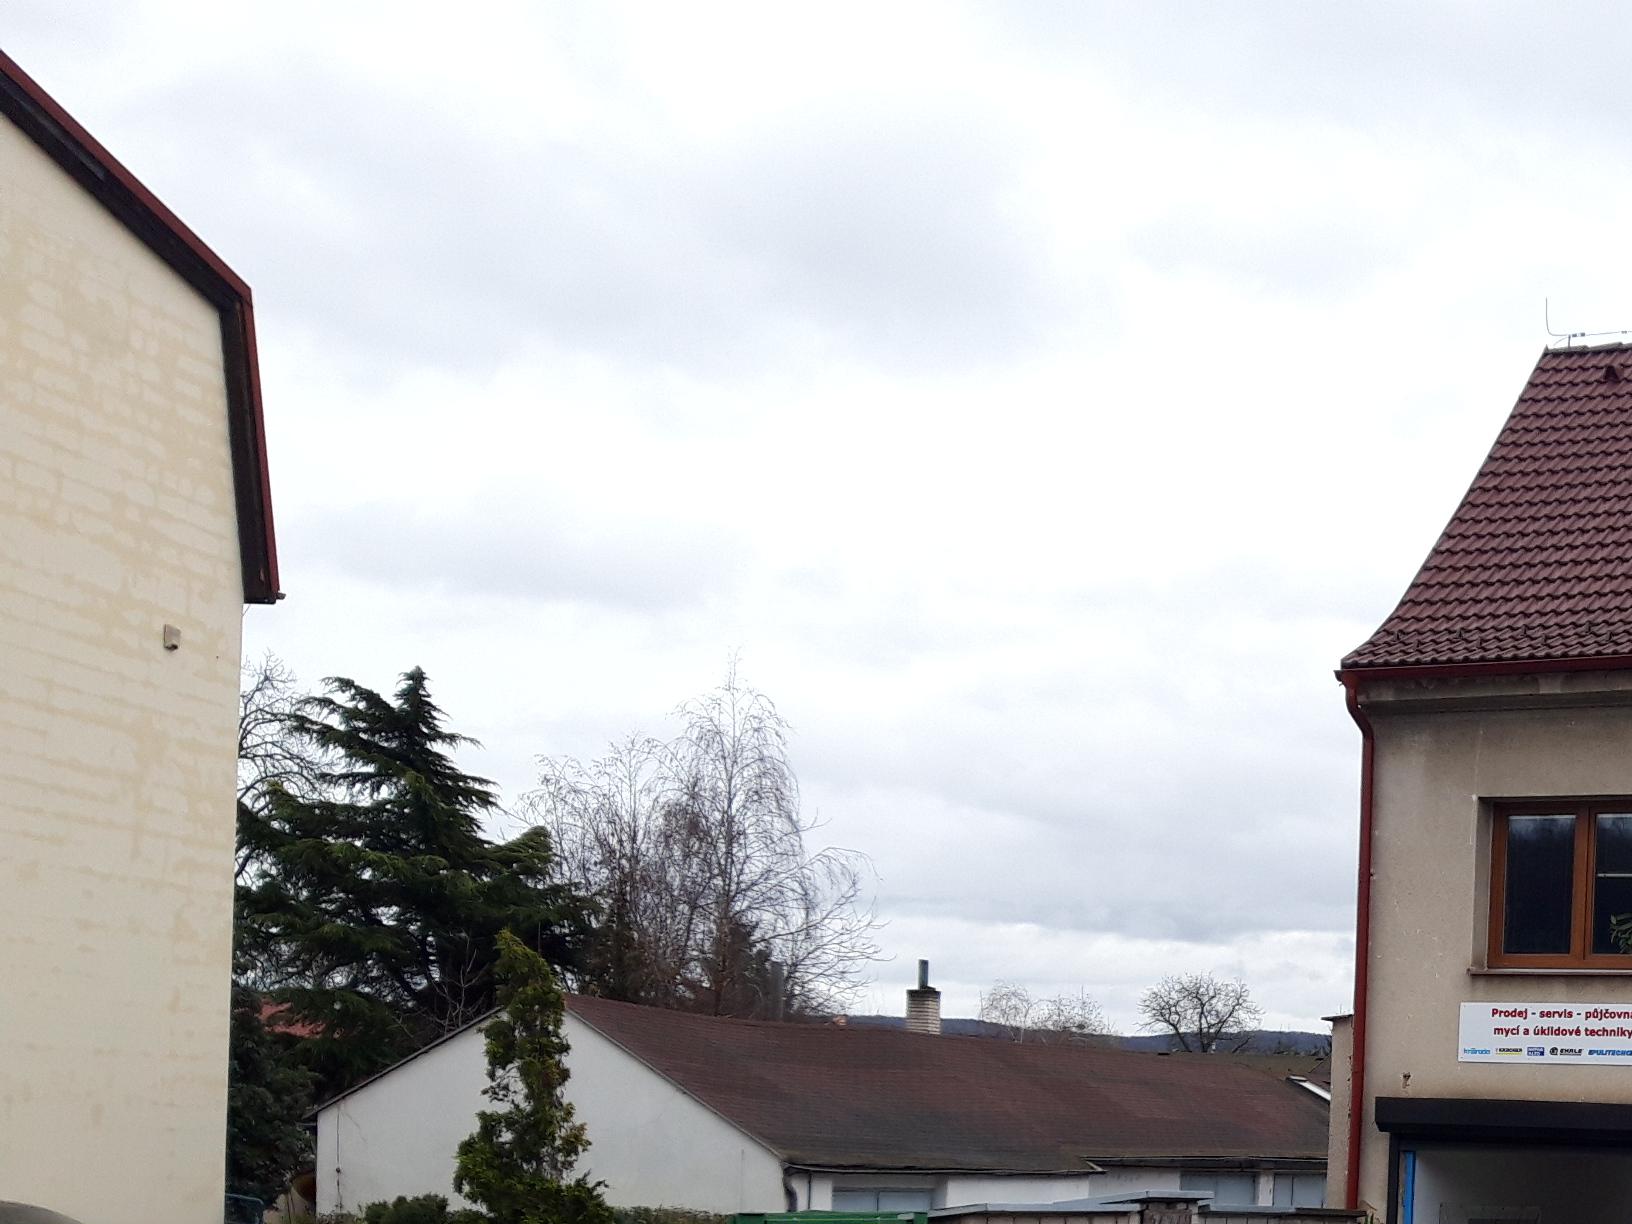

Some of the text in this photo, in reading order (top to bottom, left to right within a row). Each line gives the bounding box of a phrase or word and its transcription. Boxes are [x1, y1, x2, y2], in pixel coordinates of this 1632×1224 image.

[1491, 1008, 1527, 1020] Prodej
[1539, 1009, 1573, 1019] servis
[1493, 1026, 1520, 1038] mycí
[1523, 1028, 1530, 1036] a
[1533, 1026, 1581, 1037] úklidové
